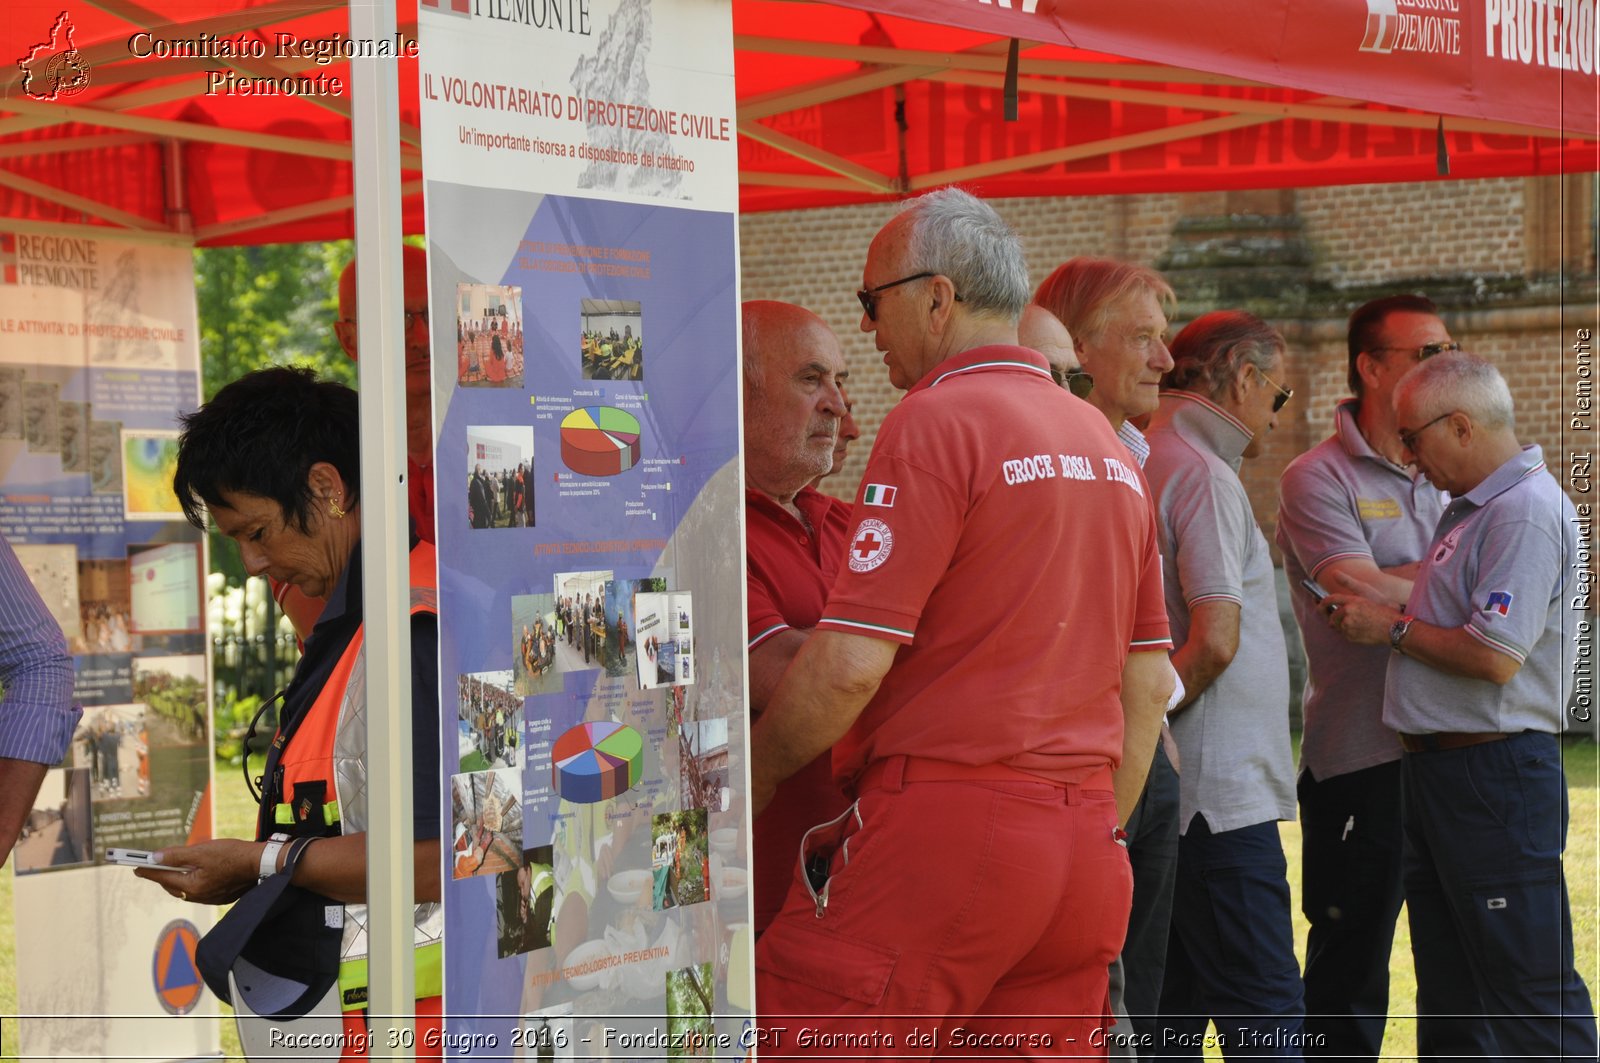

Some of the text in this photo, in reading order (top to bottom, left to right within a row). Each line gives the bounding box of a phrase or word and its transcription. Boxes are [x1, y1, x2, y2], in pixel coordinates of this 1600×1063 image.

[1394, 13, 1461, 56] PIEMONTE
[424, 72, 438, 101] IL
[441, 75, 563, 119] VOLONTARIATO
[567, 95, 583, 122] DI
[587, 98, 677, 136] PROTEZIONE
[681, 113, 730, 142] CIVILE
[532, 136, 566, 158] risorsa
[569, 146, 575, 158] a
[578, 141, 638, 167] disposizione
[641, 150, 655, 168] del
[657, 153, 695, 173] cittadino
[19, 235, 97, 265] REGIONE
[20, 264, 99, 290] PIEMONTE
[1, 319, 14, 332] LE
[68, 324, 80, 336] DI
[83, 324, 149, 341] PROTEZIONE
[151, 328, 184, 342] CIVILE
[1003, 455, 1056, 486] CROCE
[623, 946, 669, 965] PREVENTIVA
